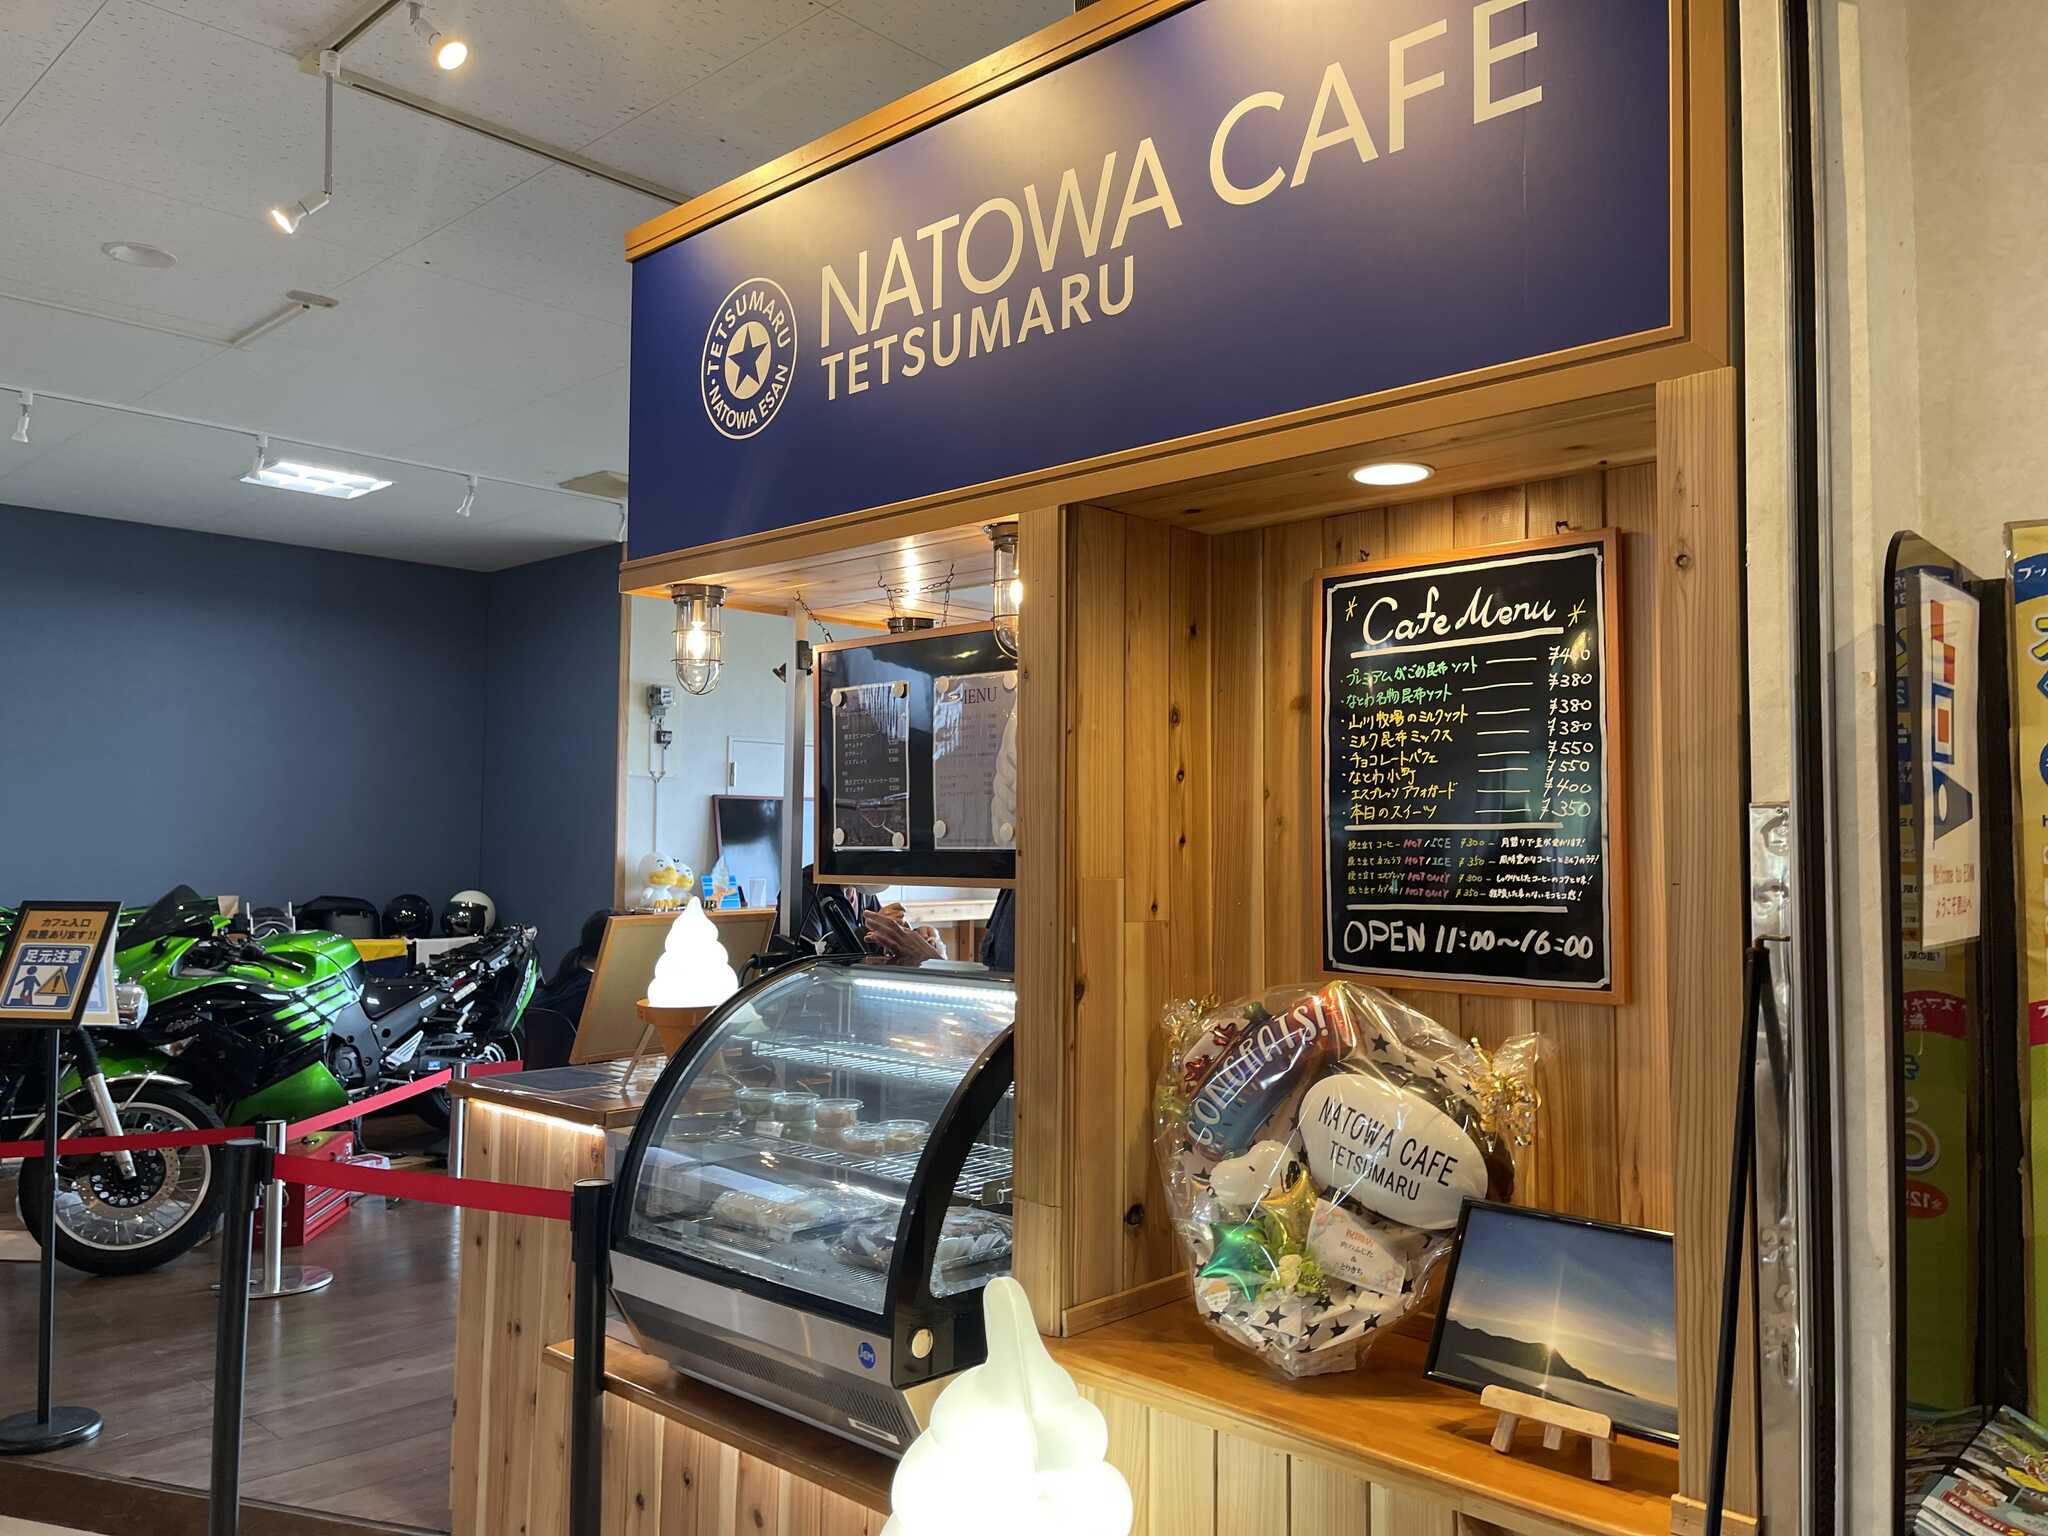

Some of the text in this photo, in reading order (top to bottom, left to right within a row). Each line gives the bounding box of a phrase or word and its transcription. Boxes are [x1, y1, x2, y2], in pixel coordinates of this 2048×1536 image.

[820, 0, 1543, 348] NATOWA CAFE
[707, 290, 791, 375] TETSUMARU
[821, 255, 1136, 401] TETSUMARU
[709, 364, 789, 430] NATOWA ESAN
[1362, 586, 1557, 646] Cafe Menu
[1548, 672, 1593, 692] ¥380
[1348, 698, 1592, 730] 山川牧場のミルクソフト ¥380
[1349, 717, 1593, 751] ミルク昆布ミックス ¥380
[1349, 740, 1594, 769] チョコレートパフェ ¥550
[1348, 759, 1591, 786] なとわ小町 ¥550
[1543, 777, 1593, 798] ¥400
[1350, 797, 1592, 824] 本日のスイーツ ¥350
[41, 917, 93, 928] カフェ入口
[1344, 920, 1425, 953] OPEN
[23, 949, 83, 964] 足元注意
[1187, 1002, 1329, 1146] CONGRATS!
[1319, 1095, 1459, 1188] NATOWA CAFE
[1329, 1141, 1422, 1201] TETSUMARU
